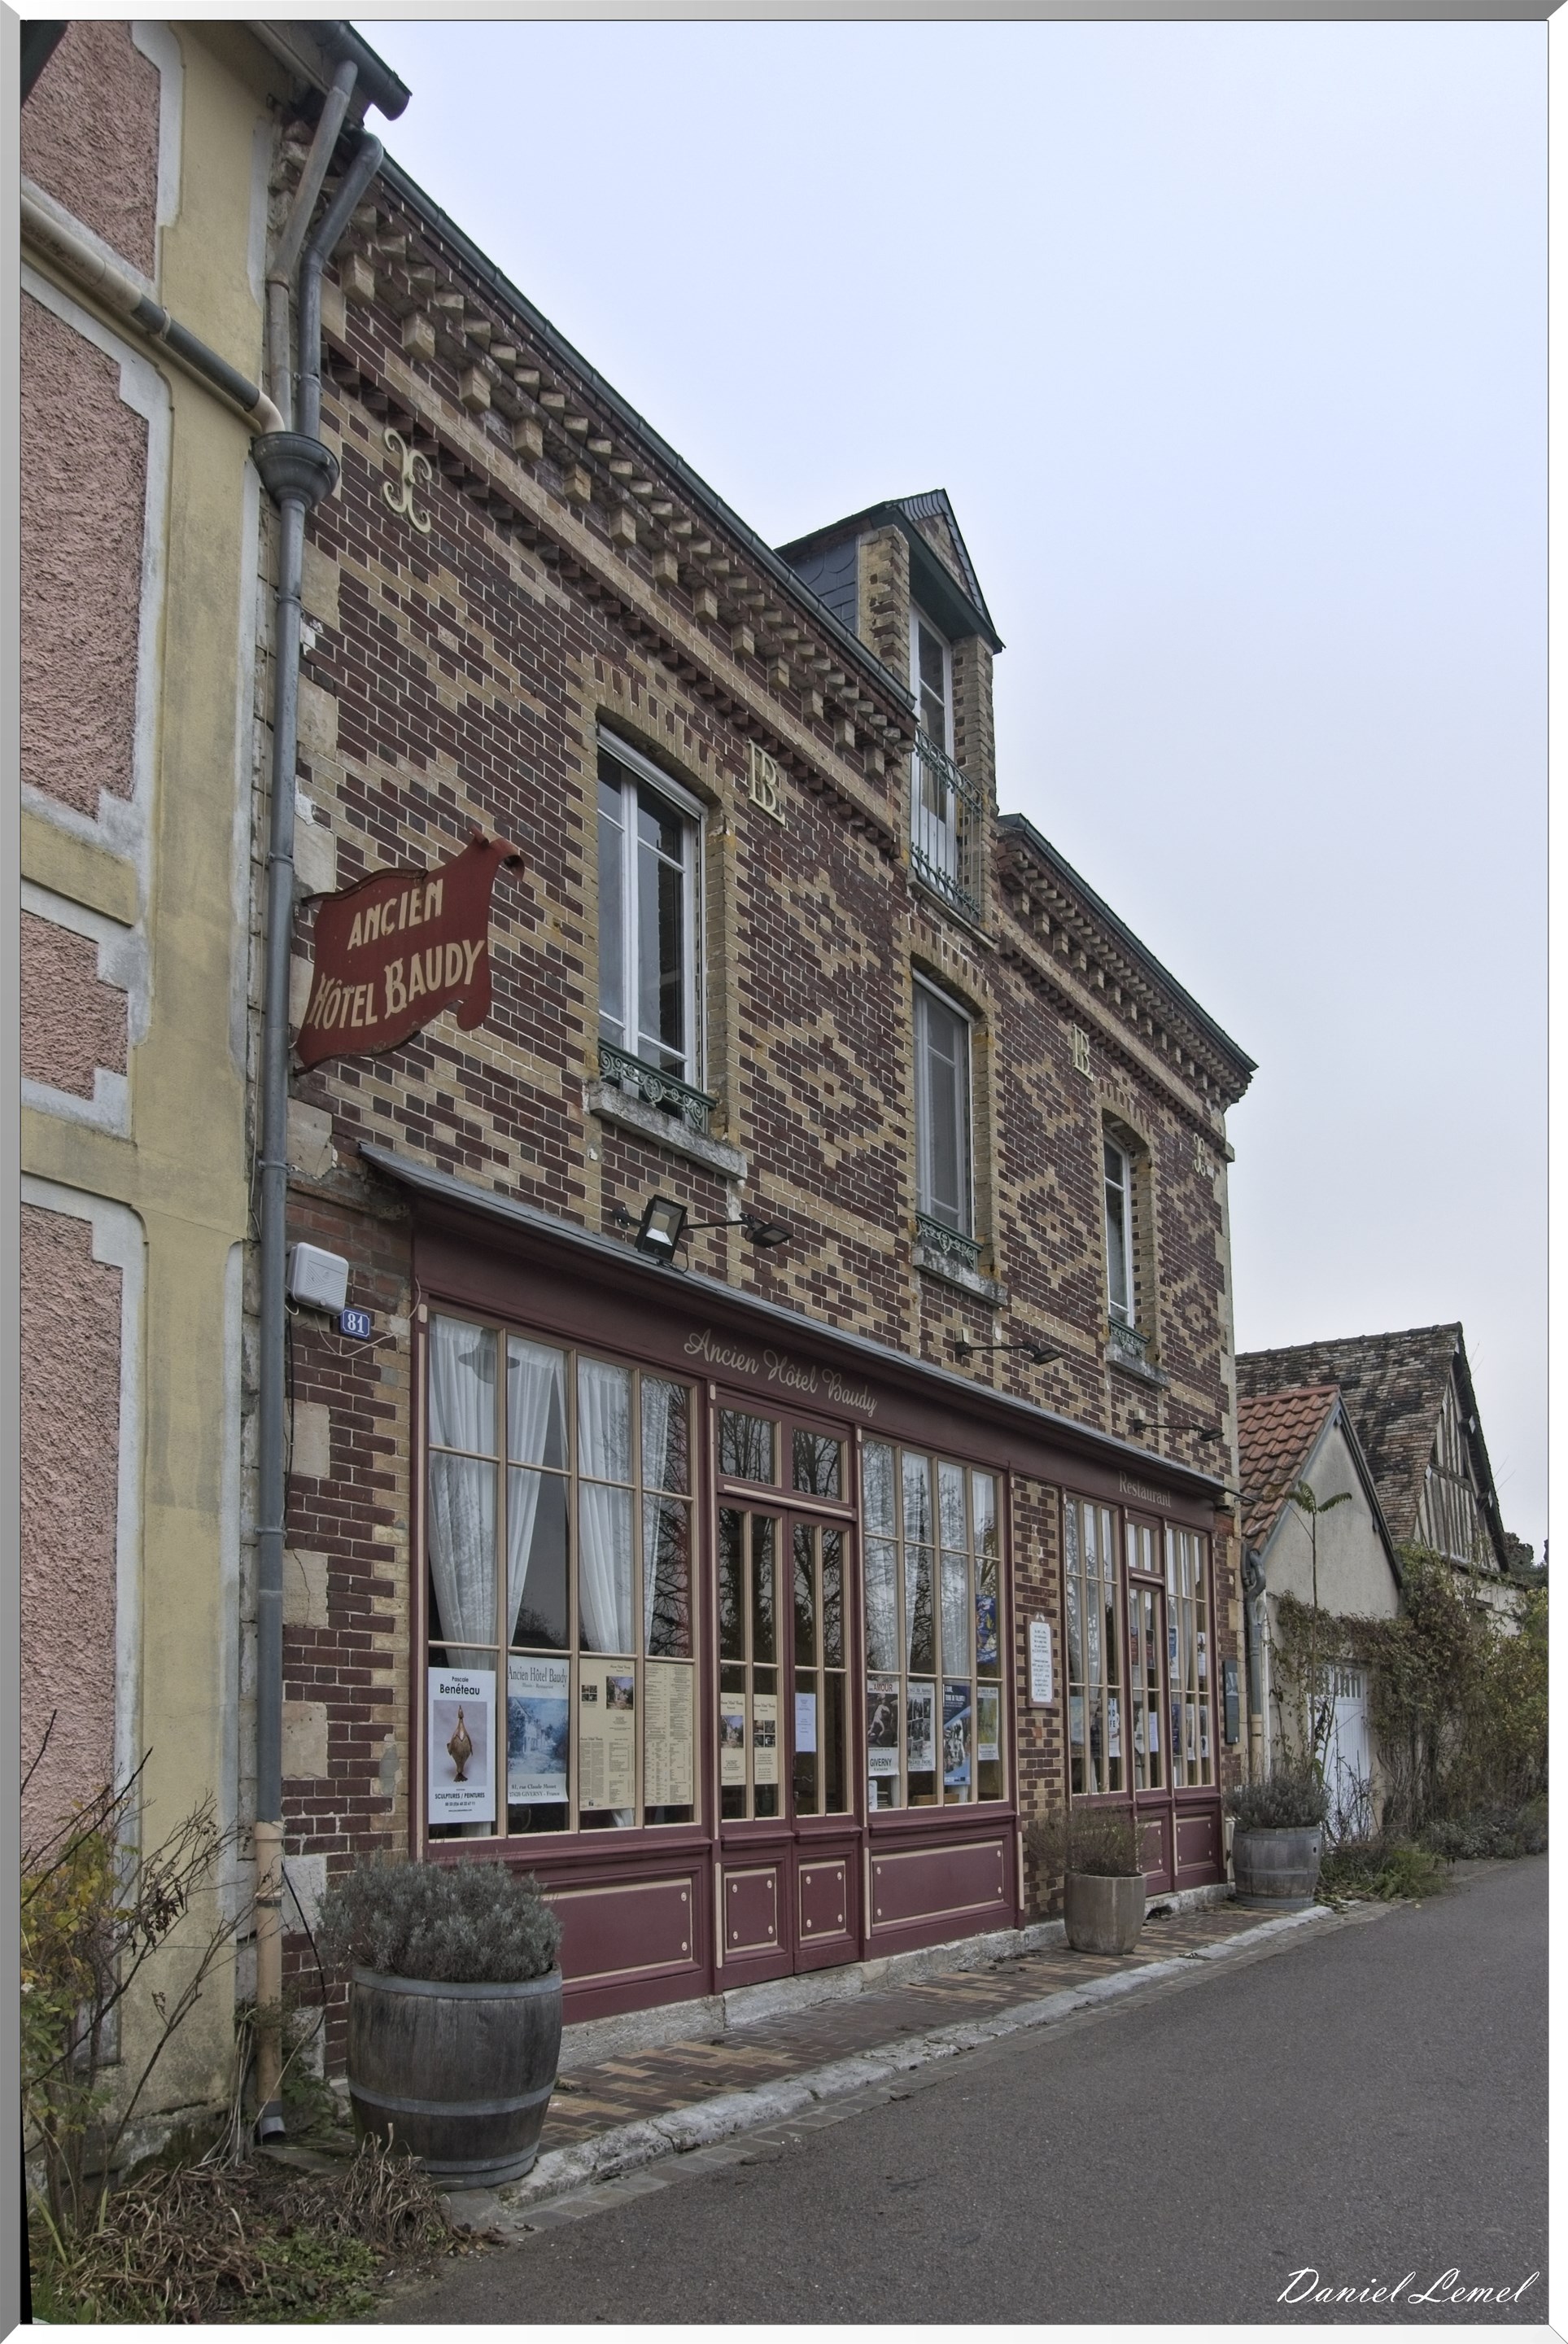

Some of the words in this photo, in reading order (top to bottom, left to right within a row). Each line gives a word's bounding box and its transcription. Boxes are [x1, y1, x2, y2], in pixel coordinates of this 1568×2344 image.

[347, 878, 443, 951] ANCIEN
[307, 973, 378, 1030] HÔTEL
[384, 939, 485, 1020] BAUDY
[347, 1313, 365, 1334] 81
[684, 1328, 759, 1375] Ancien
[763, 1349, 818, 1393] Hôtel
[822, 1368, 877, 1417] Baudy
[1118, 1470, 1172, 1507] Restaurant
[508, 1665, 528, 1680] Ancien
[530, 1667, 548, 1682] Hôtel
[549, 1668, 567, 1687] Baudy
[439, 1683, 480, 1695] Benéteau
[873, 1683, 893, 1692] AMOUR
[870, 1758, 893, 1767] GIVERNY
